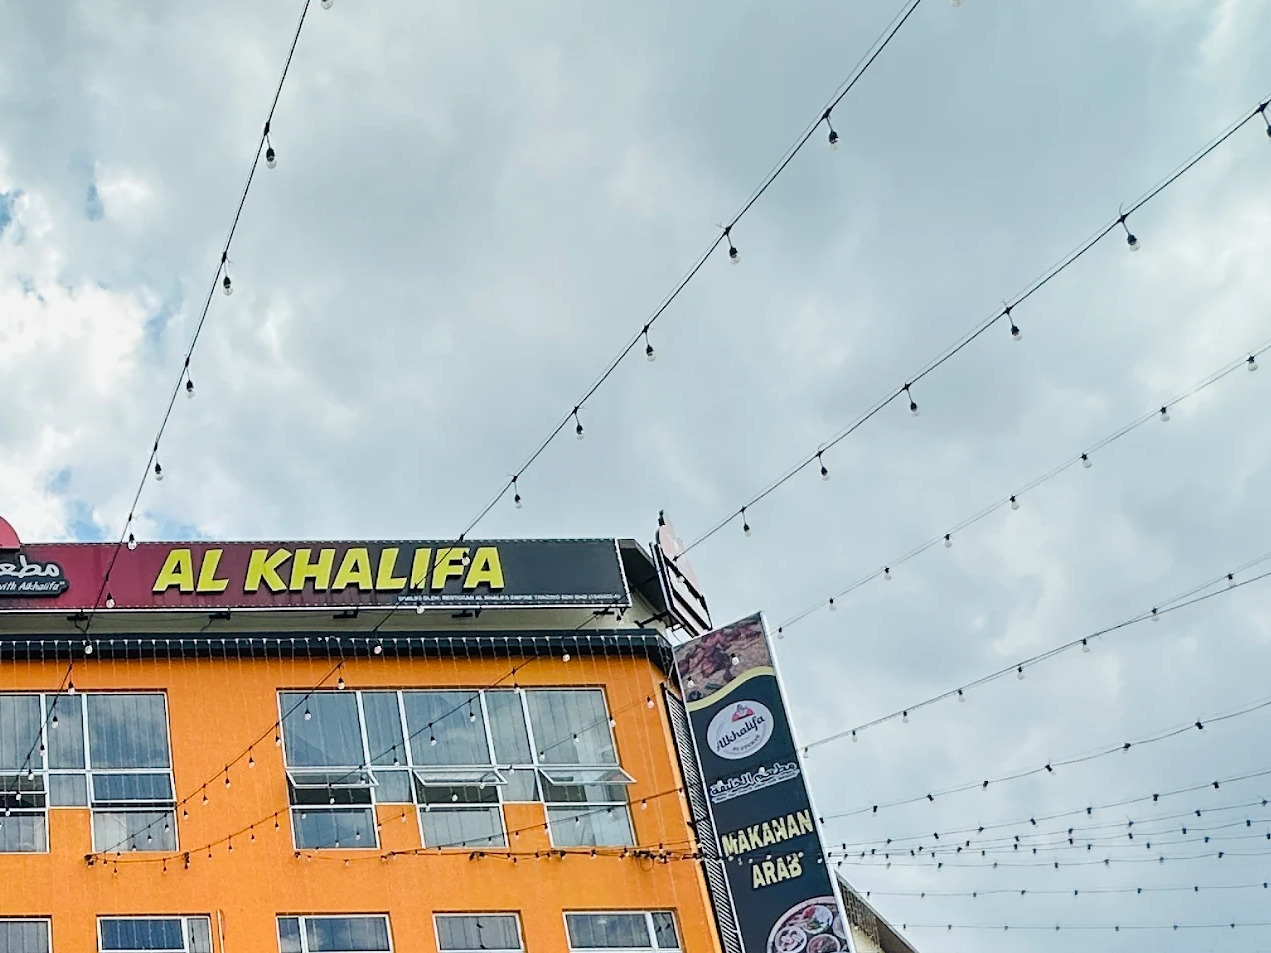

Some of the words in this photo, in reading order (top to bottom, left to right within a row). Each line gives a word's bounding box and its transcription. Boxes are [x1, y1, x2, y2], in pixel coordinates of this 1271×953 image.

[152, 548, 230, 593] AL
[244, 546, 506, 592] KHALIFA
[721, 809, 814, 857] MAKANAN
[752, 852, 803, 889] ARAB
